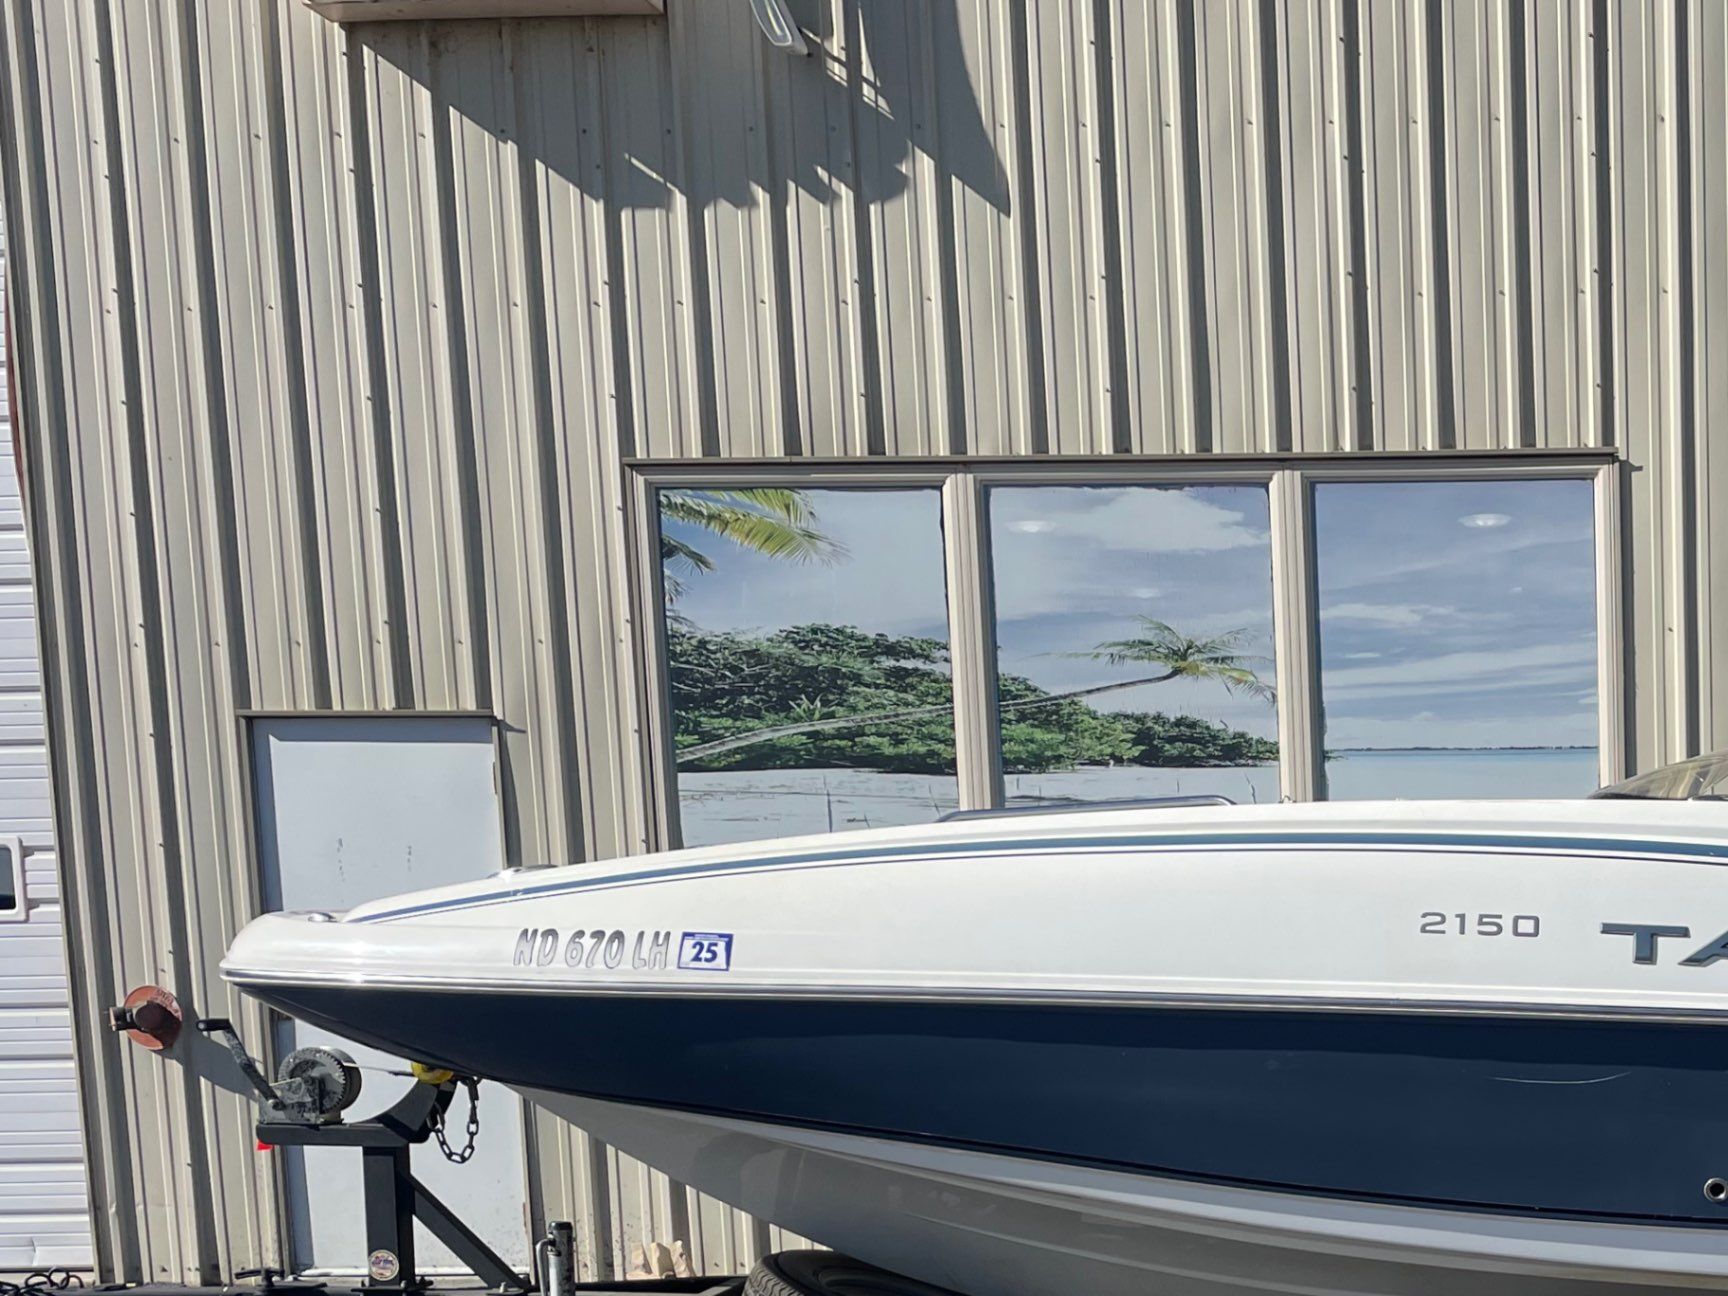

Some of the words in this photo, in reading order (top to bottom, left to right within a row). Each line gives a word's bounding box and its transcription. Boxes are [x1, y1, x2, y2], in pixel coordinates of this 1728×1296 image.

[1419, 911, 1541, 938] 2150
[512, 927, 560, 968] ND
[564, 929, 625, 970] 670
[631, 930, 672, 970] LH
[689, 941, 719, 964] 25
